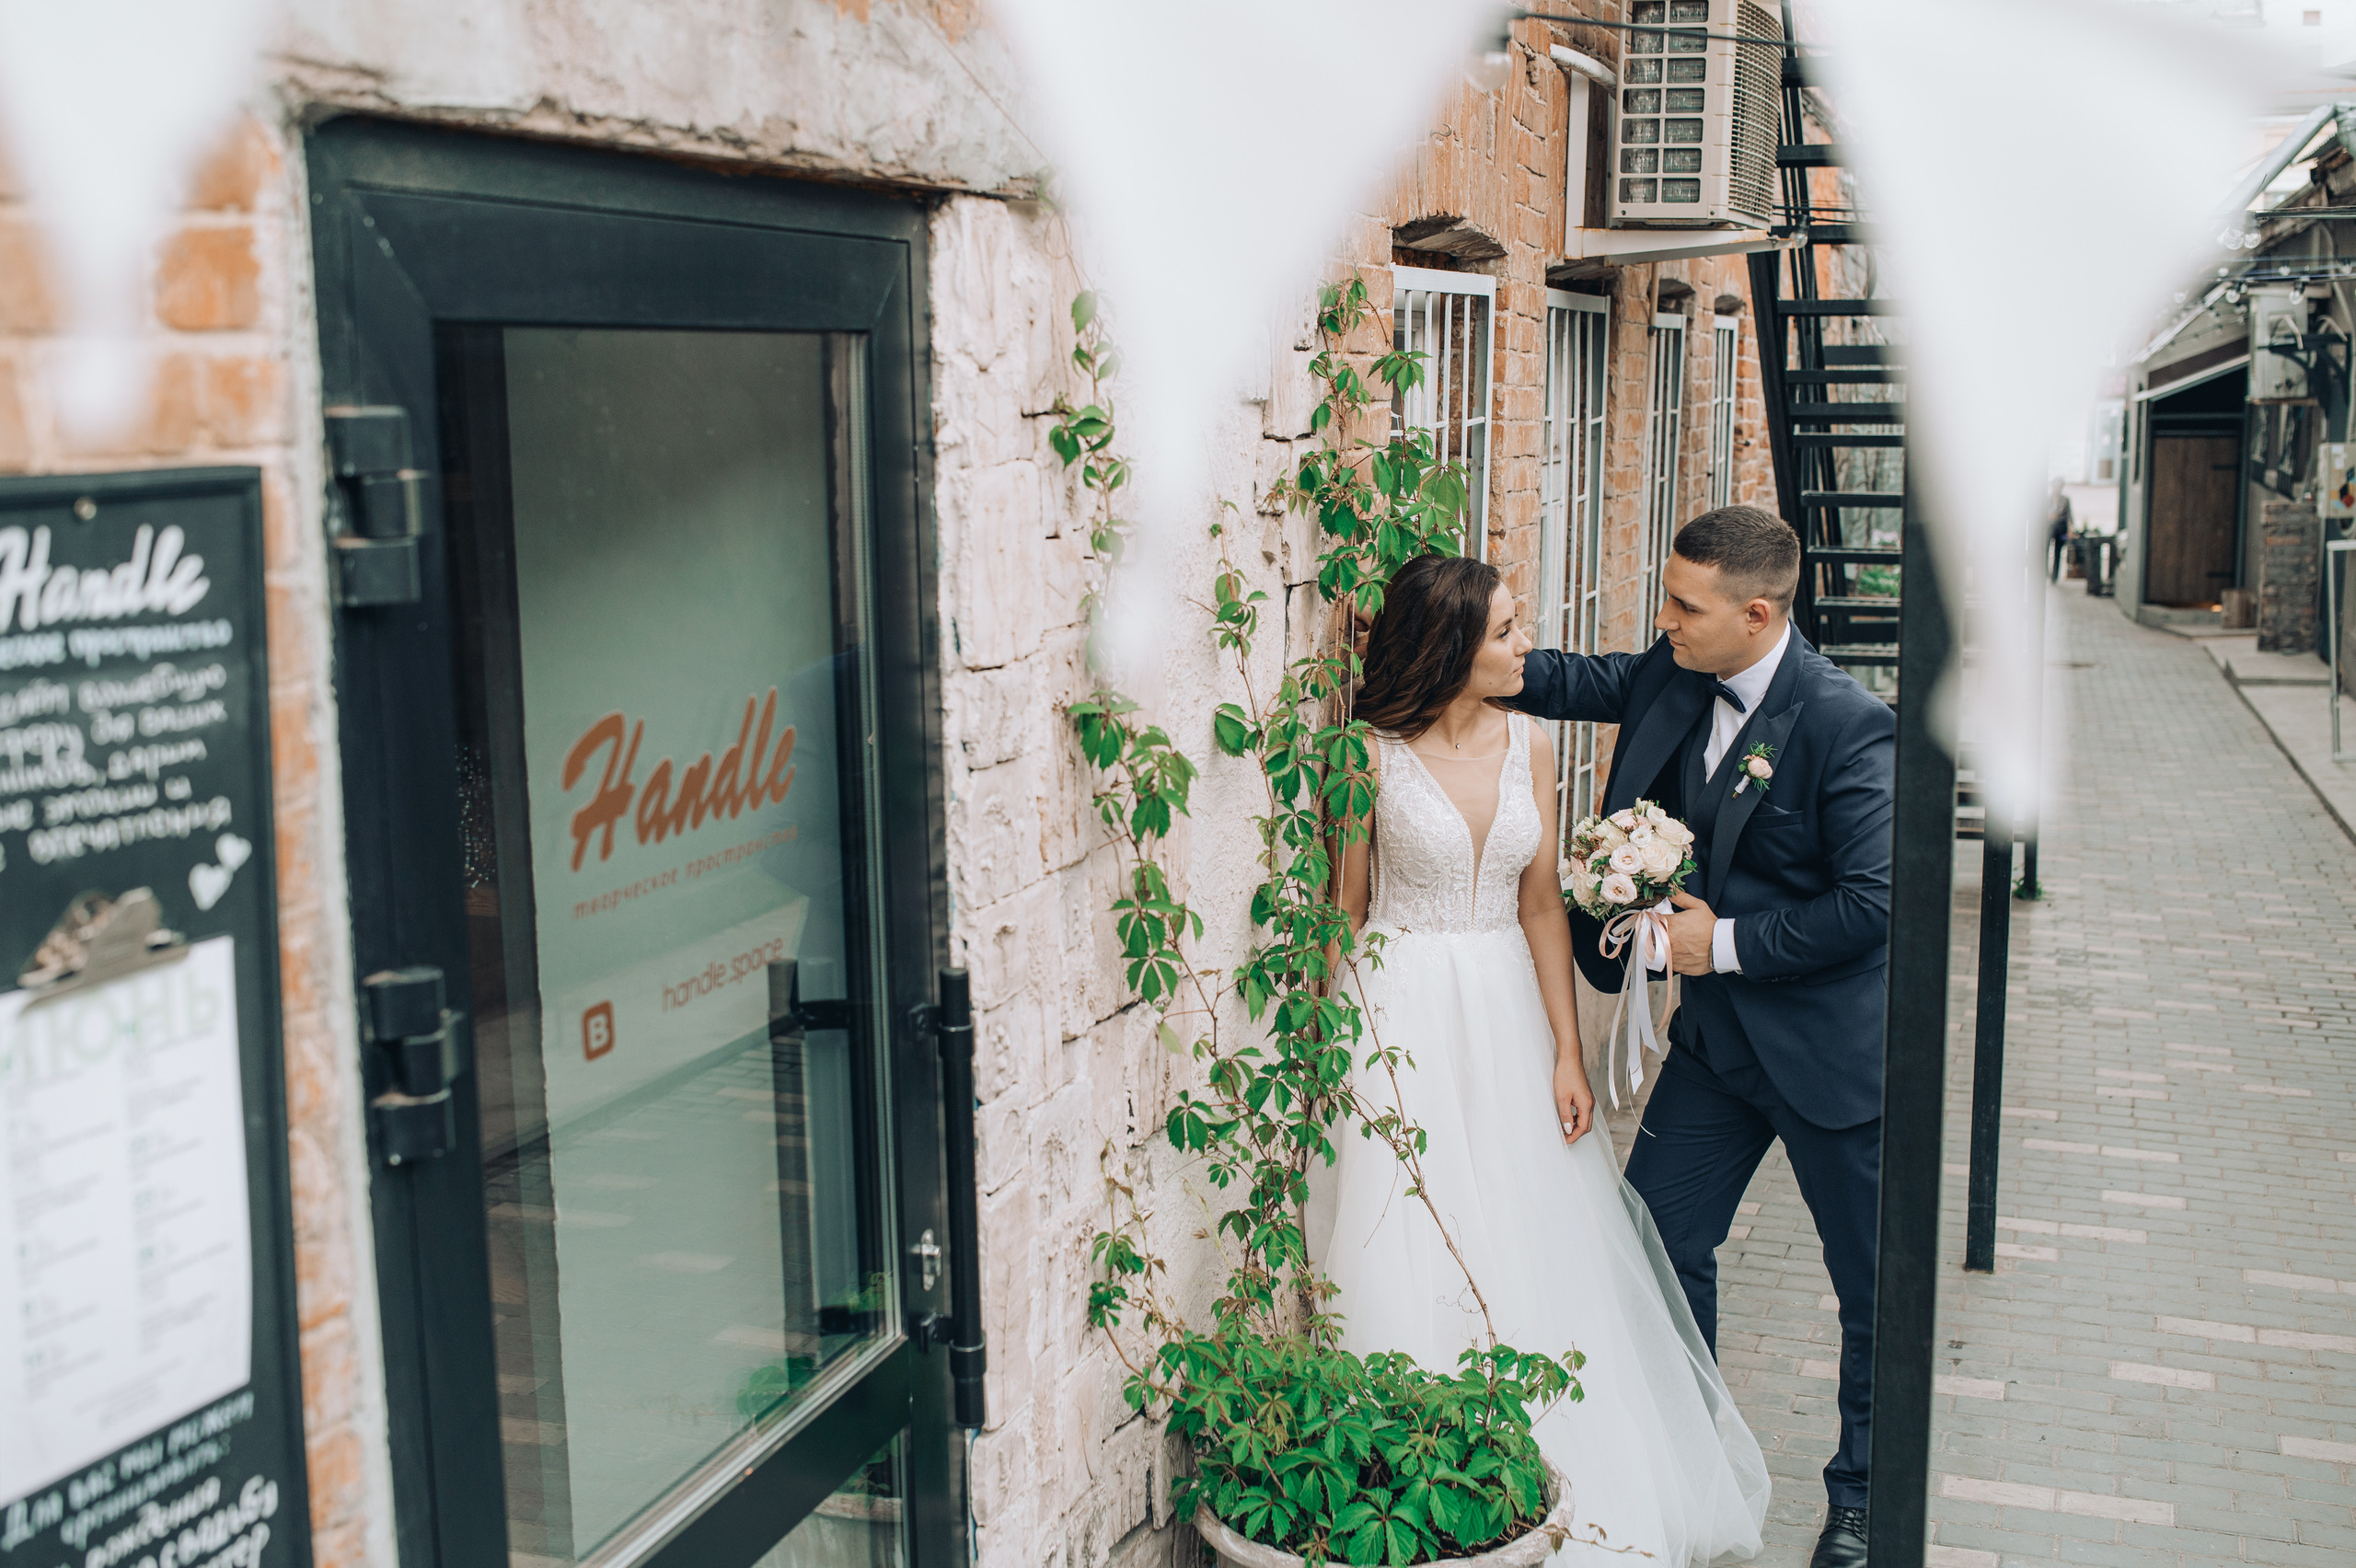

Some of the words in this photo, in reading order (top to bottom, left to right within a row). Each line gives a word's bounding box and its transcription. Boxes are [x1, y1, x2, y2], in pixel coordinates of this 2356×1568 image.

[0, 524, 210, 633] Handle
[562, 685, 796, 873] Handle
[572, 868, 679, 920] творческое
[685, 825, 799, 881] пространство
[662, 937, 784, 1013] handle.space
